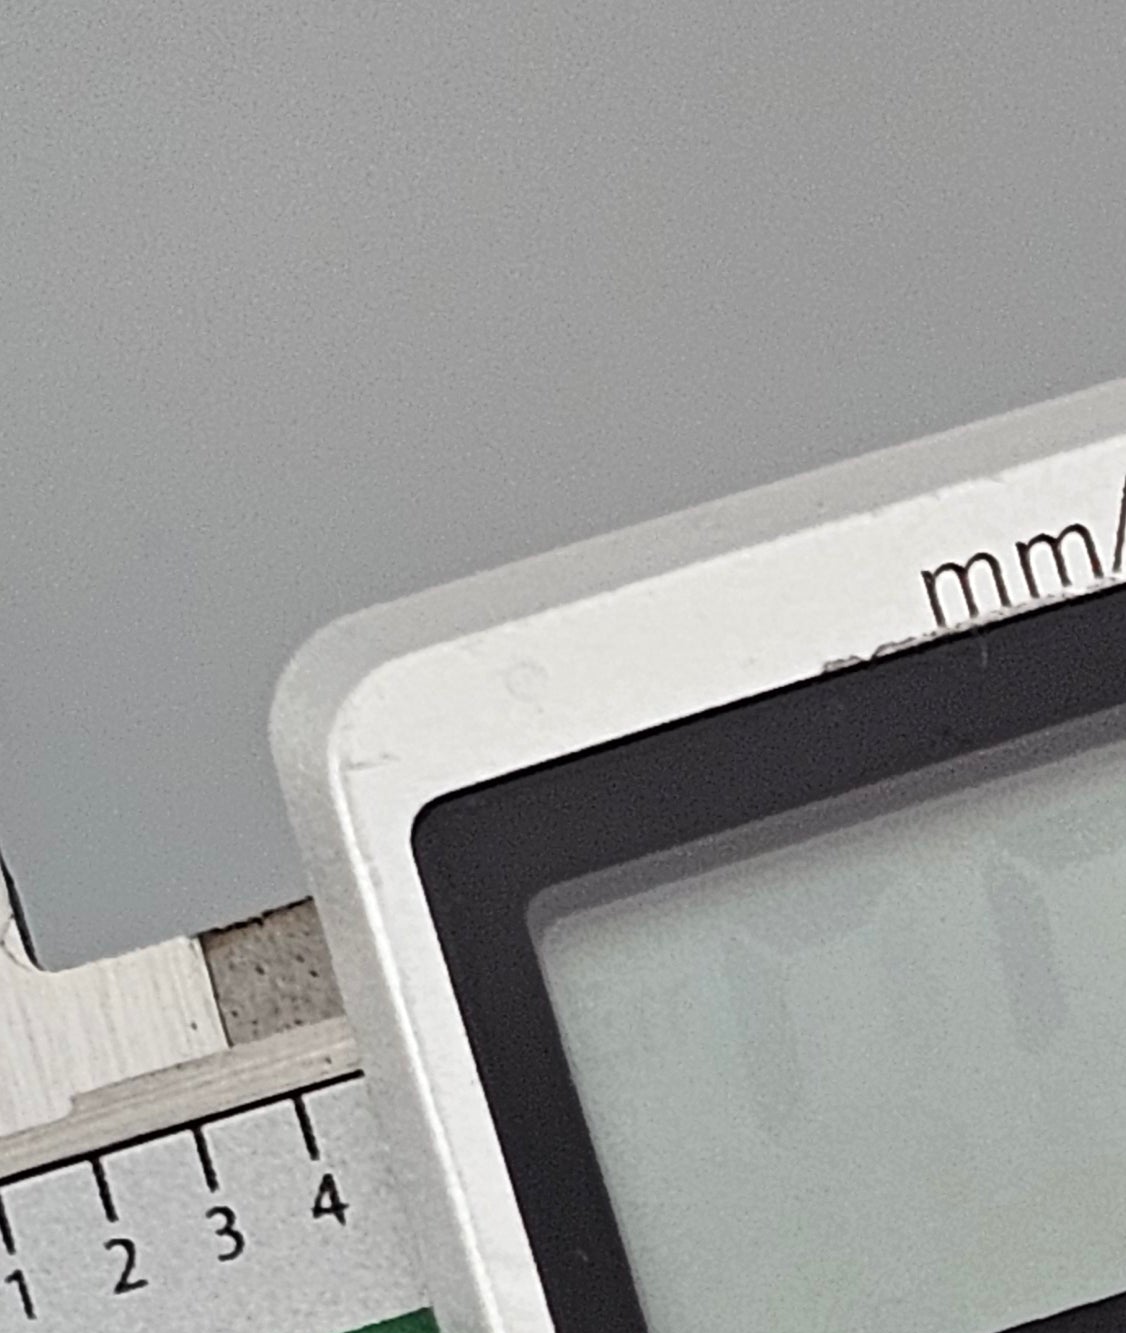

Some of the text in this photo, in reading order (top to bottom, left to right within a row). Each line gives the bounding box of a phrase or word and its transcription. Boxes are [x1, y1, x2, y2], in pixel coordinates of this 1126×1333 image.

[4, 1174, 349, 1320] 1 2 3 4
